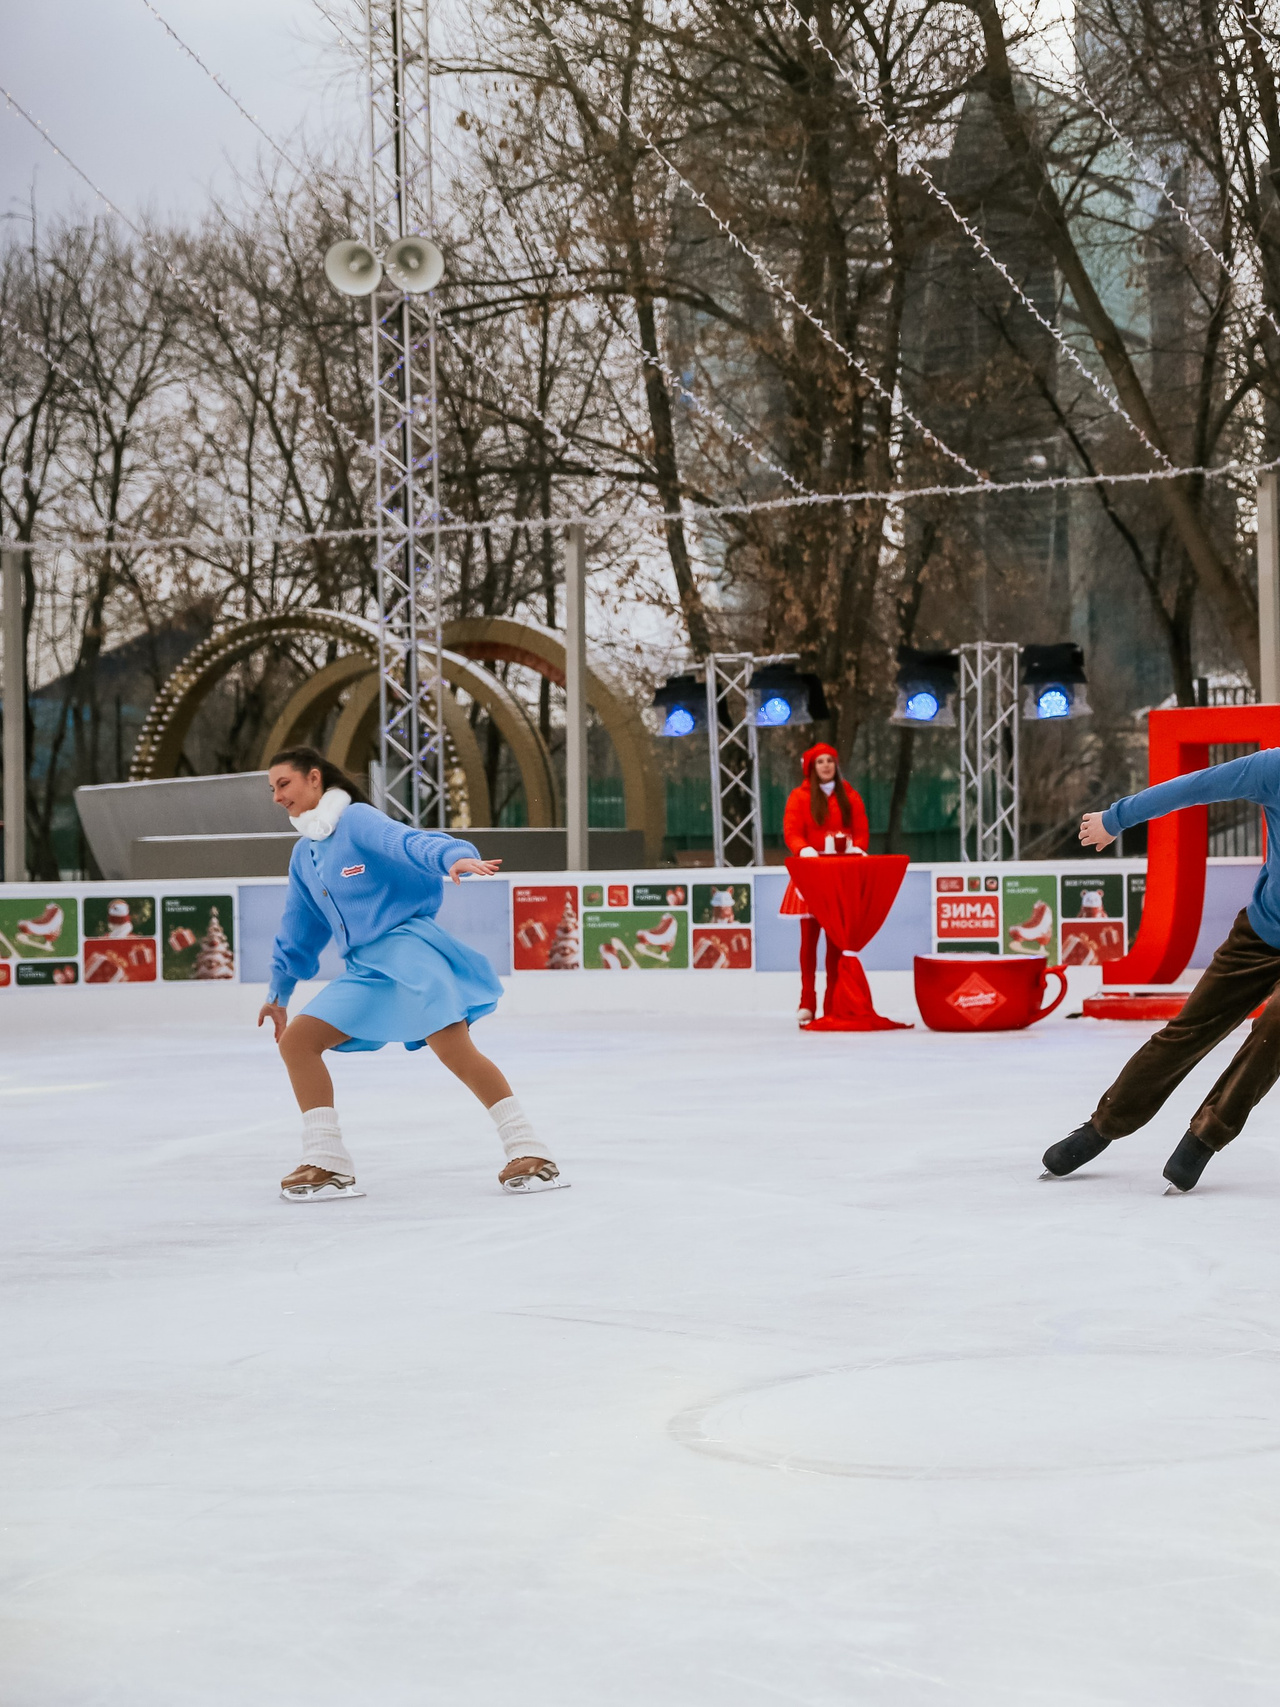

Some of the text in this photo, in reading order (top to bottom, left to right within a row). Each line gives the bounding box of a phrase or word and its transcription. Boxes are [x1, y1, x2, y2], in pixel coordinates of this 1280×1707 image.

[941, 902, 996, 919] ЗИМА
[941, 919, 996, 929] В МОСКВЕ
